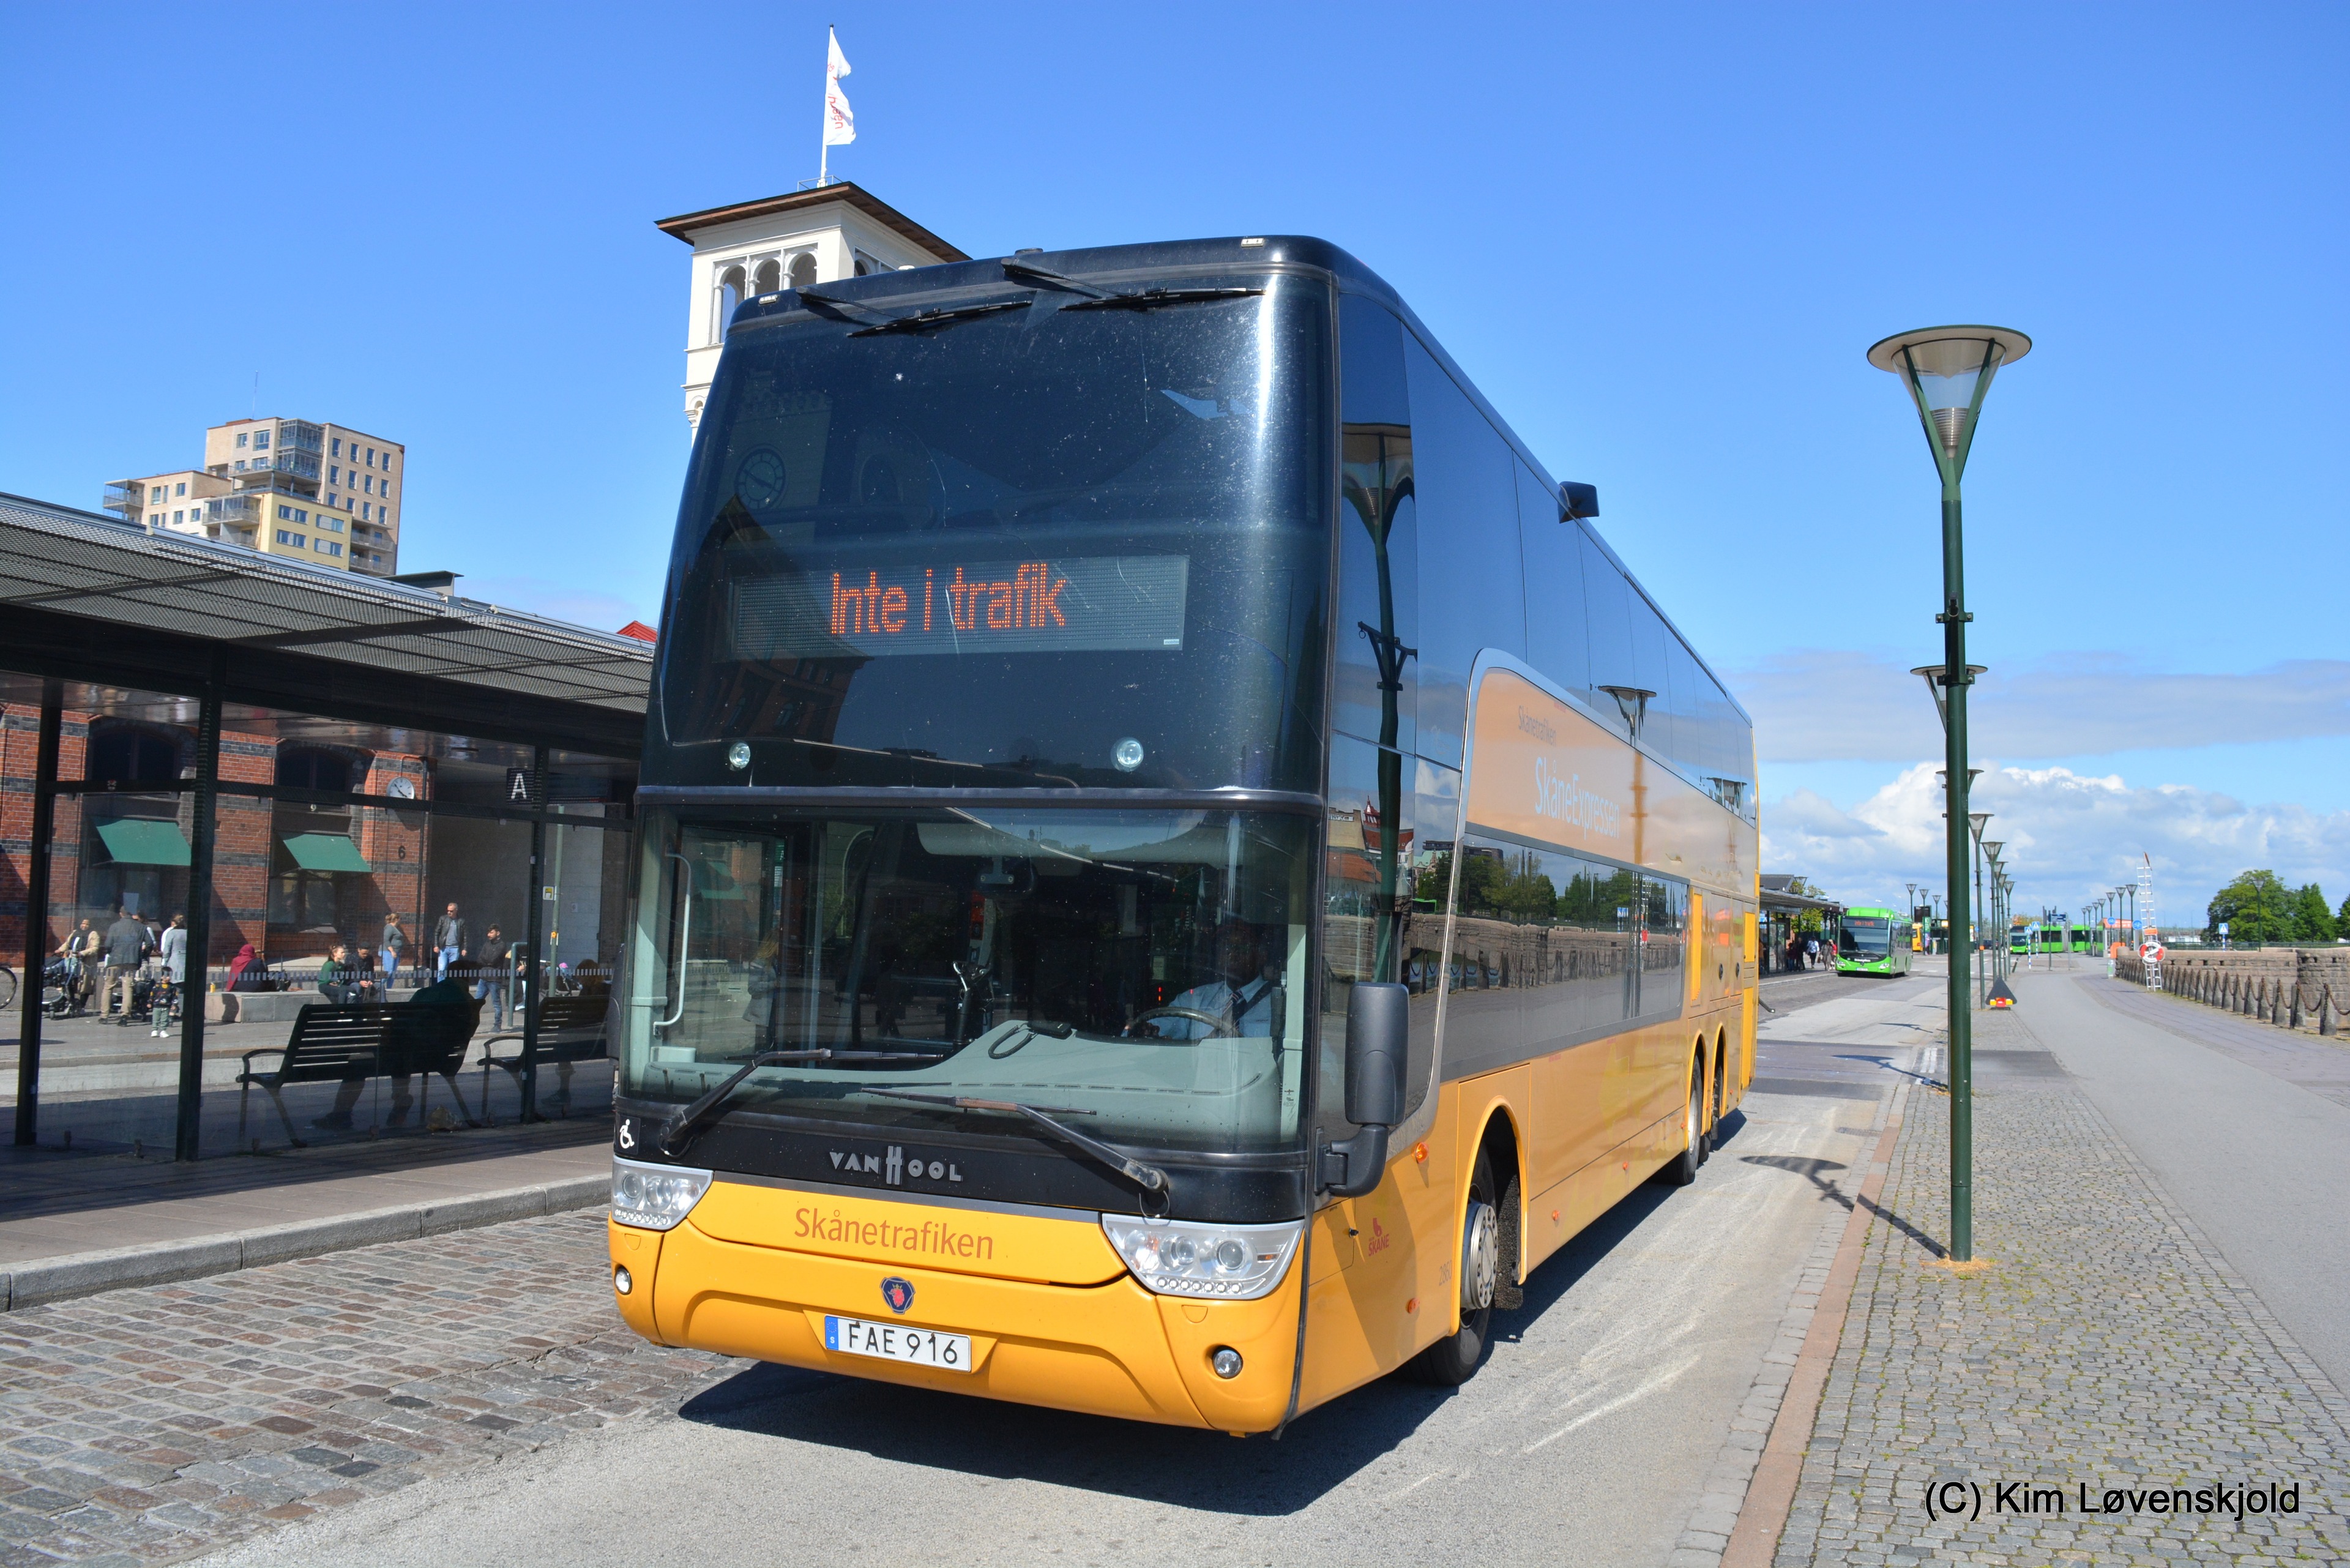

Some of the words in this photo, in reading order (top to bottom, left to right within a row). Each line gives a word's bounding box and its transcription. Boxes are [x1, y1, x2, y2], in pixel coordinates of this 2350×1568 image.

[831, 572, 908, 634] Inte
[923, 568, 933, 632] i
[949, 563, 1067, 630] trafik
[1518, 705, 1557, 747] Skånetrafiken
[510, 773, 528, 800] A
[1535, 756, 1621, 840] SkåneExpressen
[398, 845, 406, 860] 6
[794, 1208, 993, 1260] Skånetrafiken
[849, 1323, 896, 1355] FAE
[906, 1332, 958, 1364] 916
